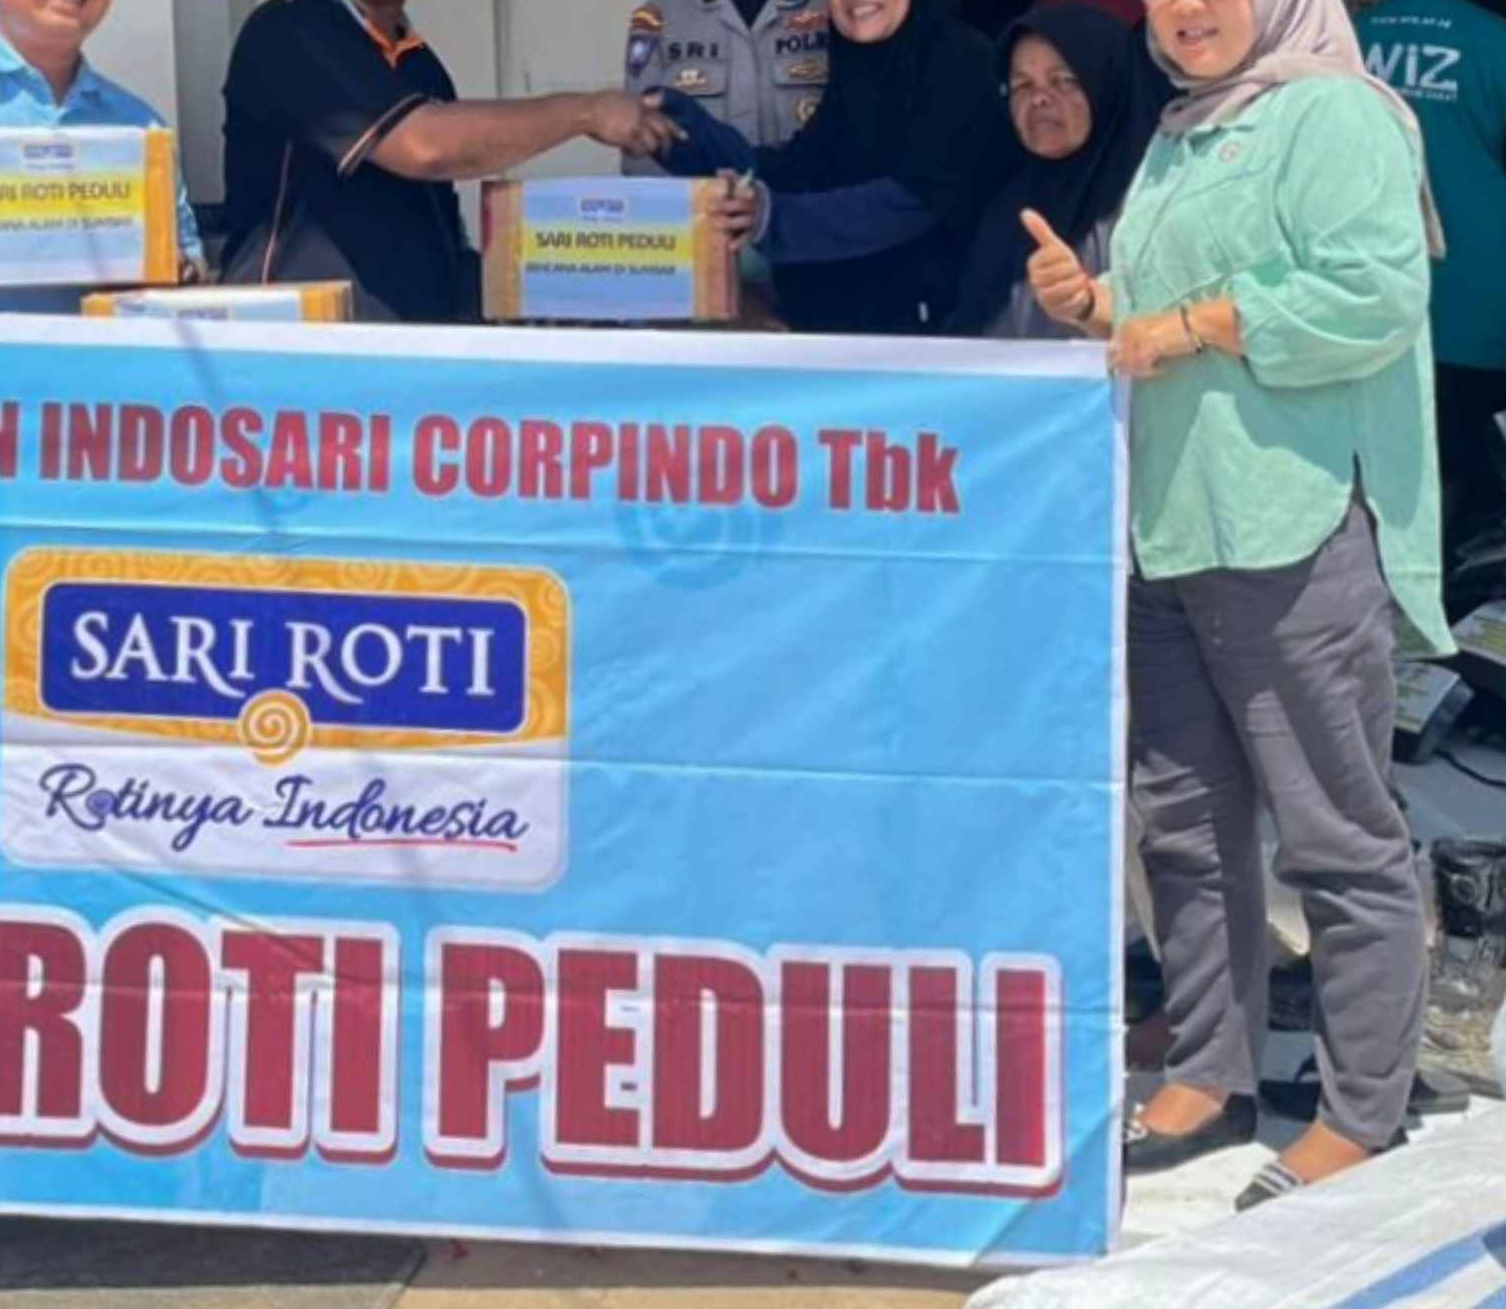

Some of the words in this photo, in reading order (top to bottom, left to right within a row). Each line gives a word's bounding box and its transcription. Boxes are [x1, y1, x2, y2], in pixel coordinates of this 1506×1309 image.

[668, 41, 719, 60] SRI
[39, 400, 389, 493] INDOSARI
[411, 414, 797, 507] CORPINDO
[816, 428, 960, 516] Tbk
[68, 607, 253, 699] SARI
[282, 622, 496, 705] ROTI
[38, 759, 251, 851] Rotinya
[266, 775, 528, 843] Indonesia
[435, 931, 1059, 1181] PEDULI
